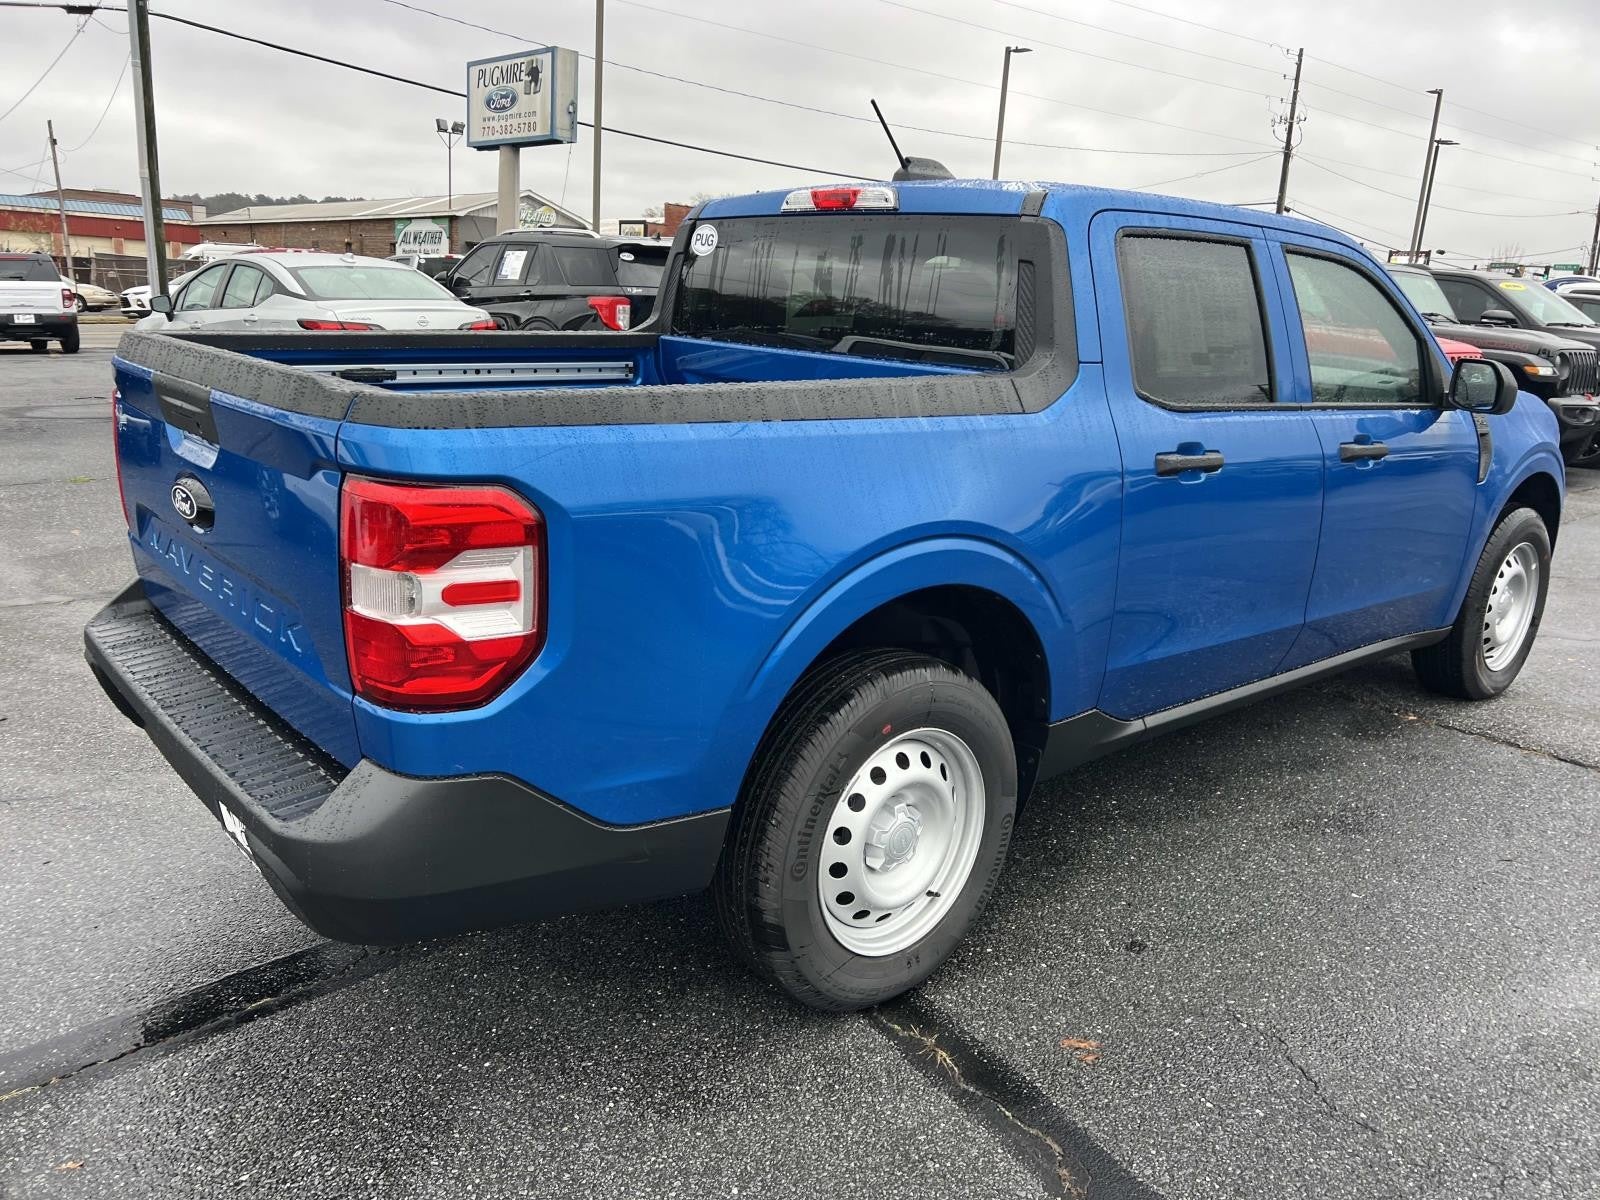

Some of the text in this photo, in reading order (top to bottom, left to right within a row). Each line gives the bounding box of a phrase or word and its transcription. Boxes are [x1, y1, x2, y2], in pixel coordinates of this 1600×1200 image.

[477, 61, 525, 88] PUGMIRE
[490, 91, 513, 109] Ford
[482, 110, 537, 123] www.pugmire.com
[481, 121, 537, 137] 770-382-5780
[400, 231, 443, 246] ALL WEATHER
[694, 233, 715, 246] PUG
[174, 489, 192, 515] Ford
[150, 531, 303, 654] MAVERICK
